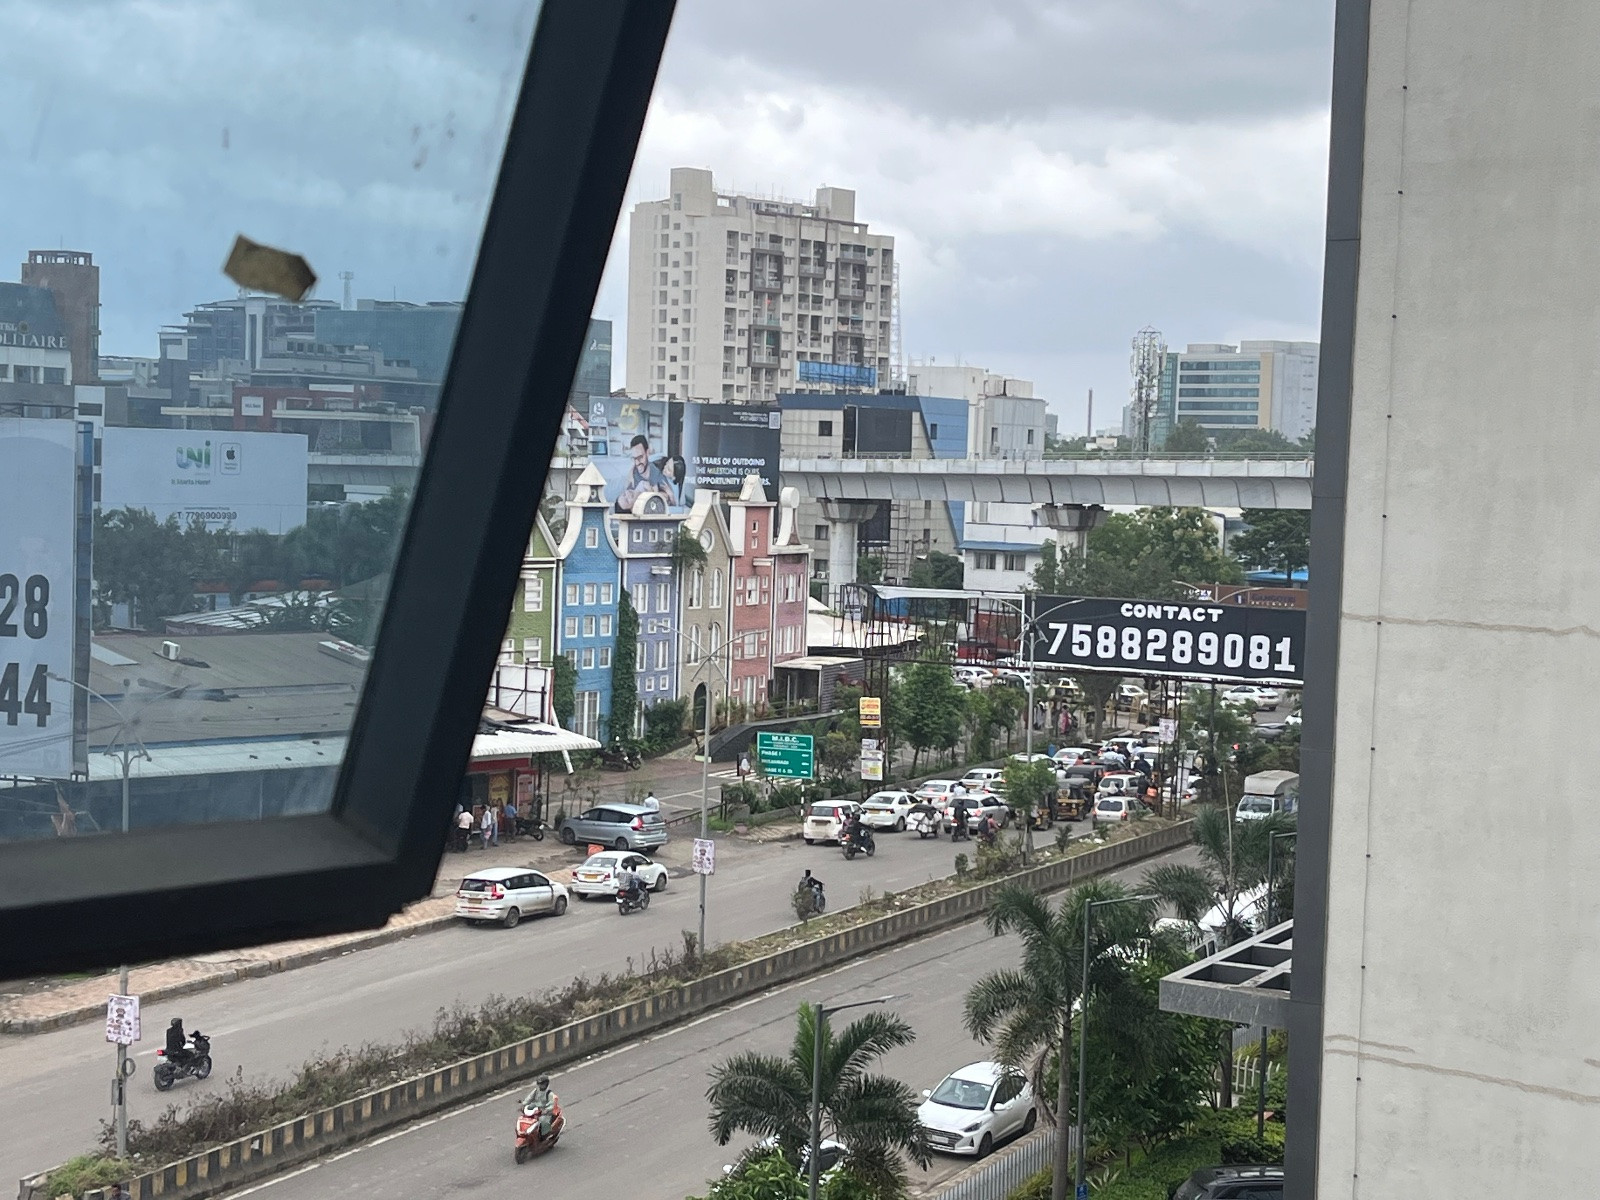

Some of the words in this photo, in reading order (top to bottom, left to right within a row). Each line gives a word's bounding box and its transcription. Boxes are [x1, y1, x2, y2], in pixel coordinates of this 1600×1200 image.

[0, 333, 68, 348] LITAIRE
[701, 456, 721, 466] YEARS
[722, 457, 731, 466] OF
[732, 457, 766, 466] OUTDOING
[696, 466, 706, 475] THE
[707, 466, 737, 475] MILESTONE
[697, 476, 740, 486] OPPORTUNITY
[0, 573, 50, 640] 28
[1120, 602, 1224, 622] CONTACT
[1047, 622, 1296, 672] 7588289081
[0, 662, 52, 728] 44
